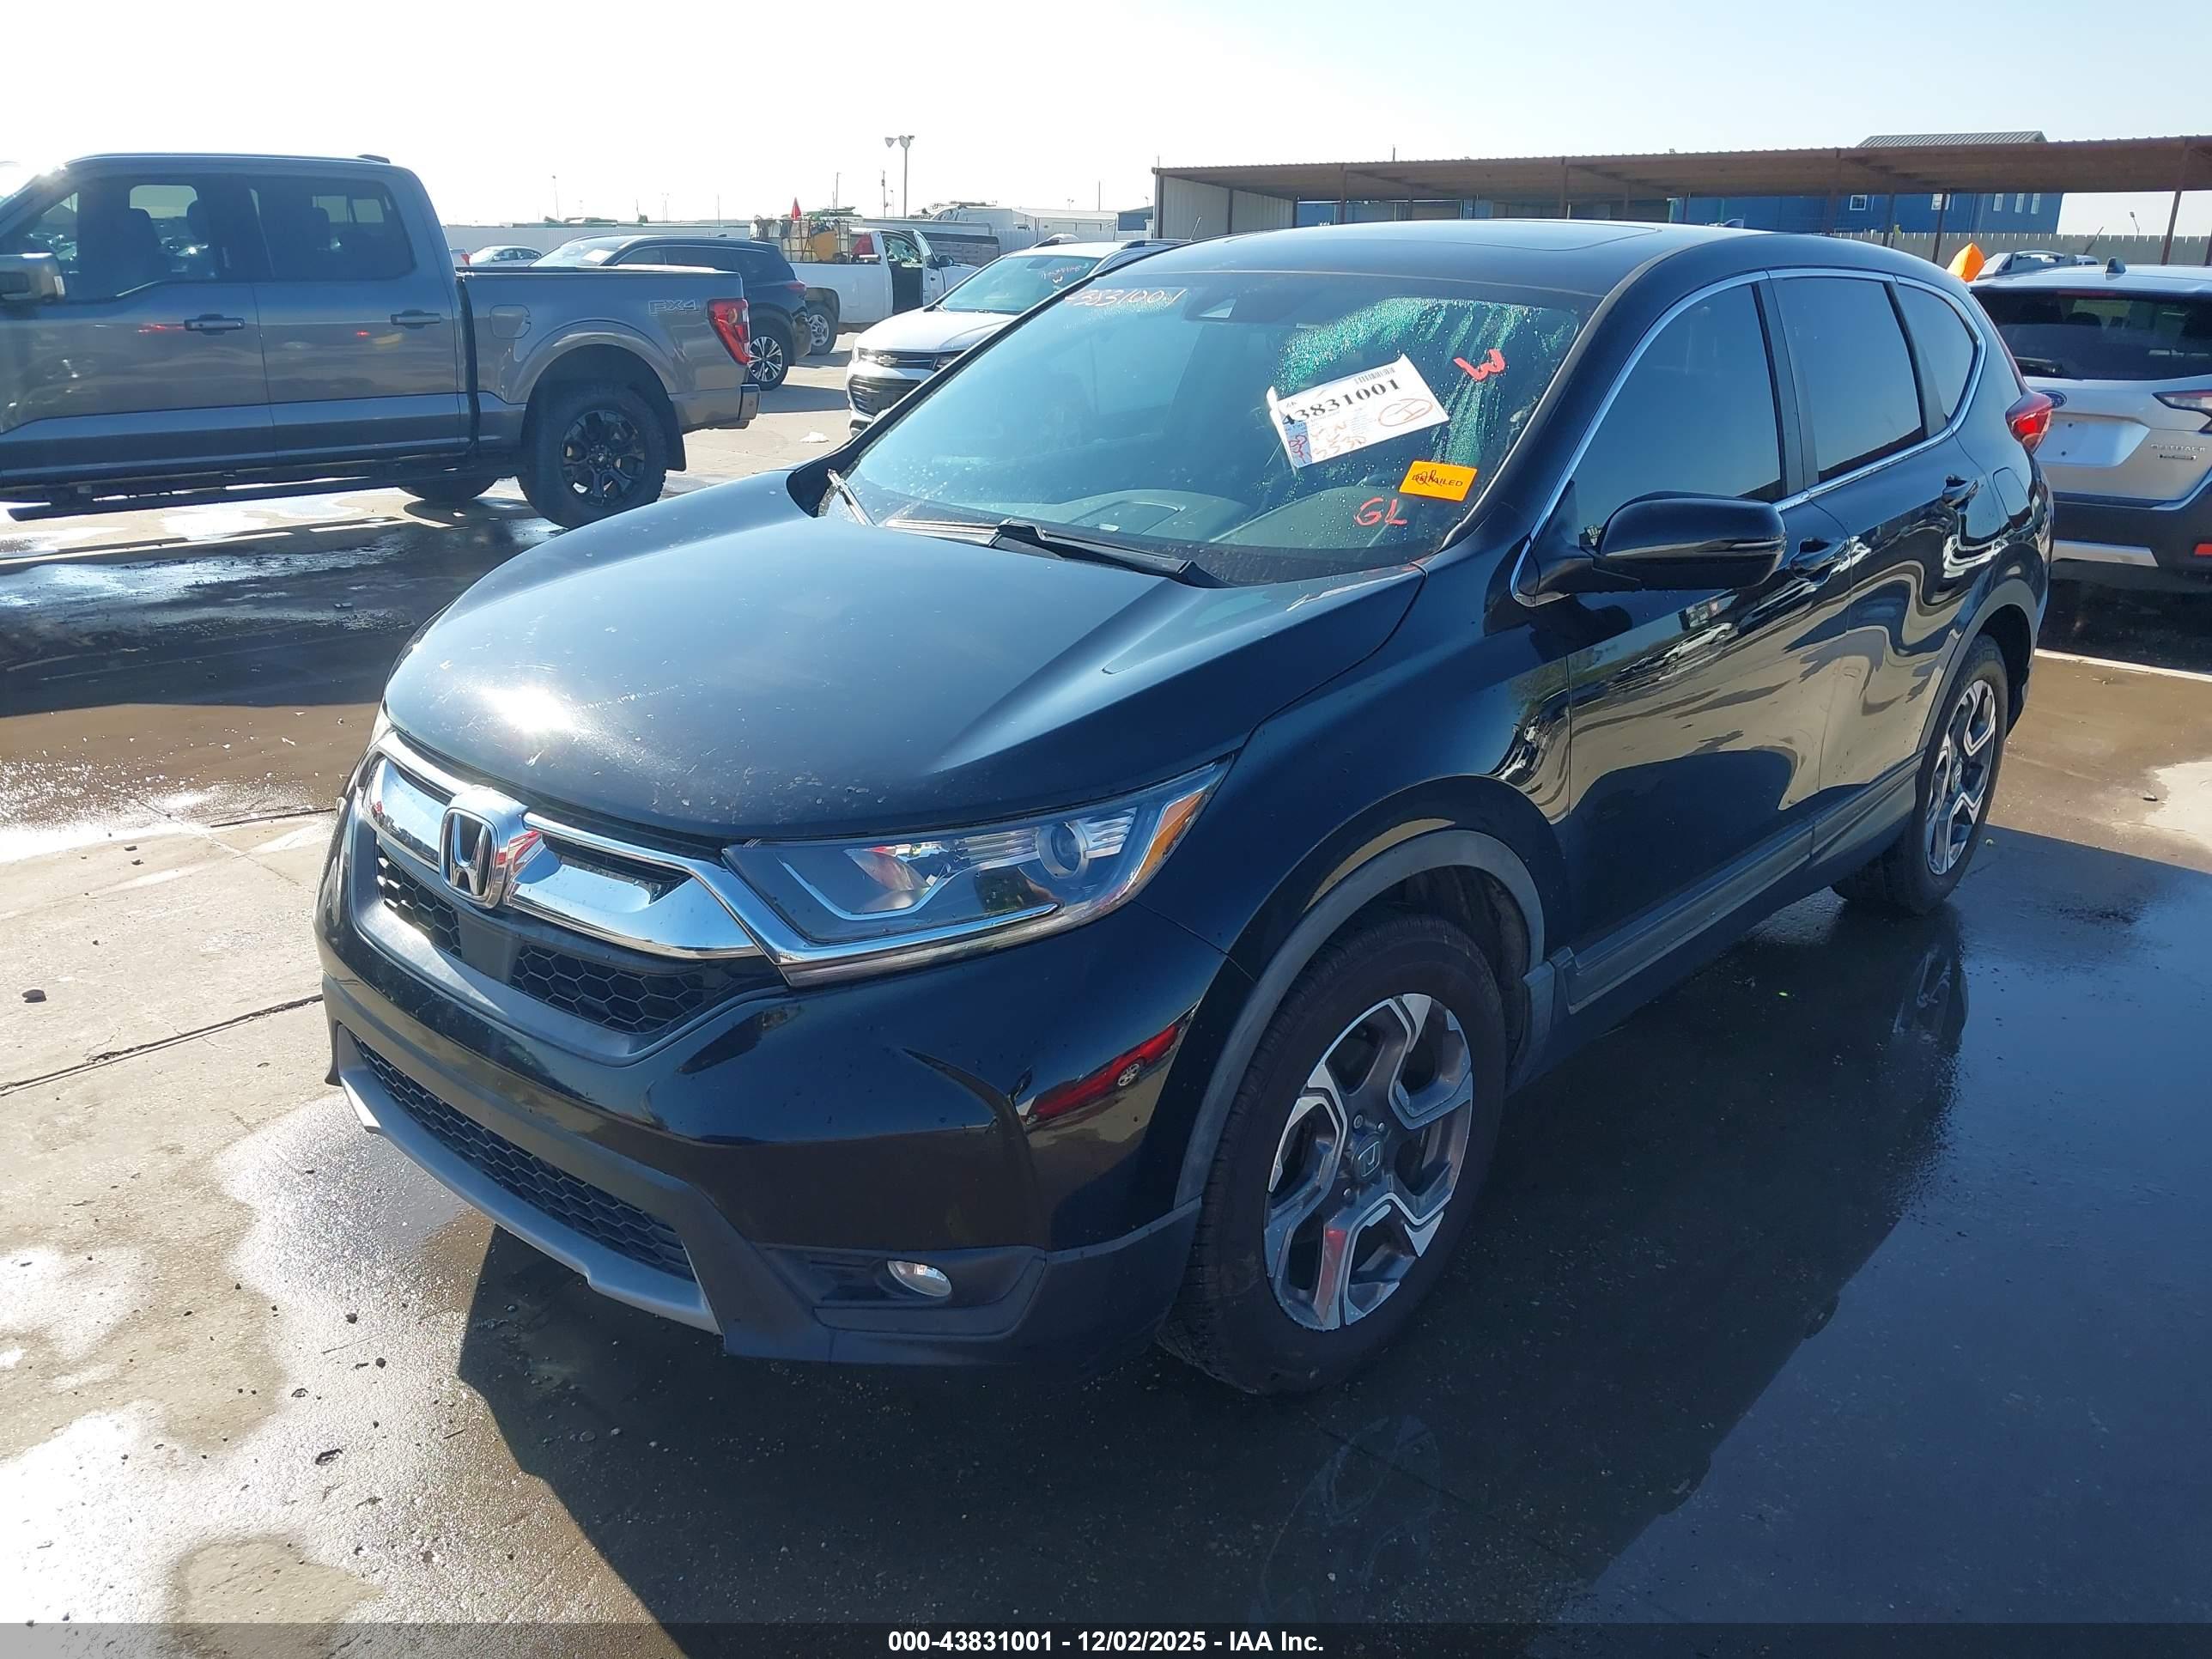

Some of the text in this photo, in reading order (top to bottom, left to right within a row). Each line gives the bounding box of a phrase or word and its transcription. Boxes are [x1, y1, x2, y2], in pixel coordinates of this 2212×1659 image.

[648, 300, 701, 316] FX4
[1283, 379, 1401, 426] 43831001
[1353, 497, 1407, 526] GL
